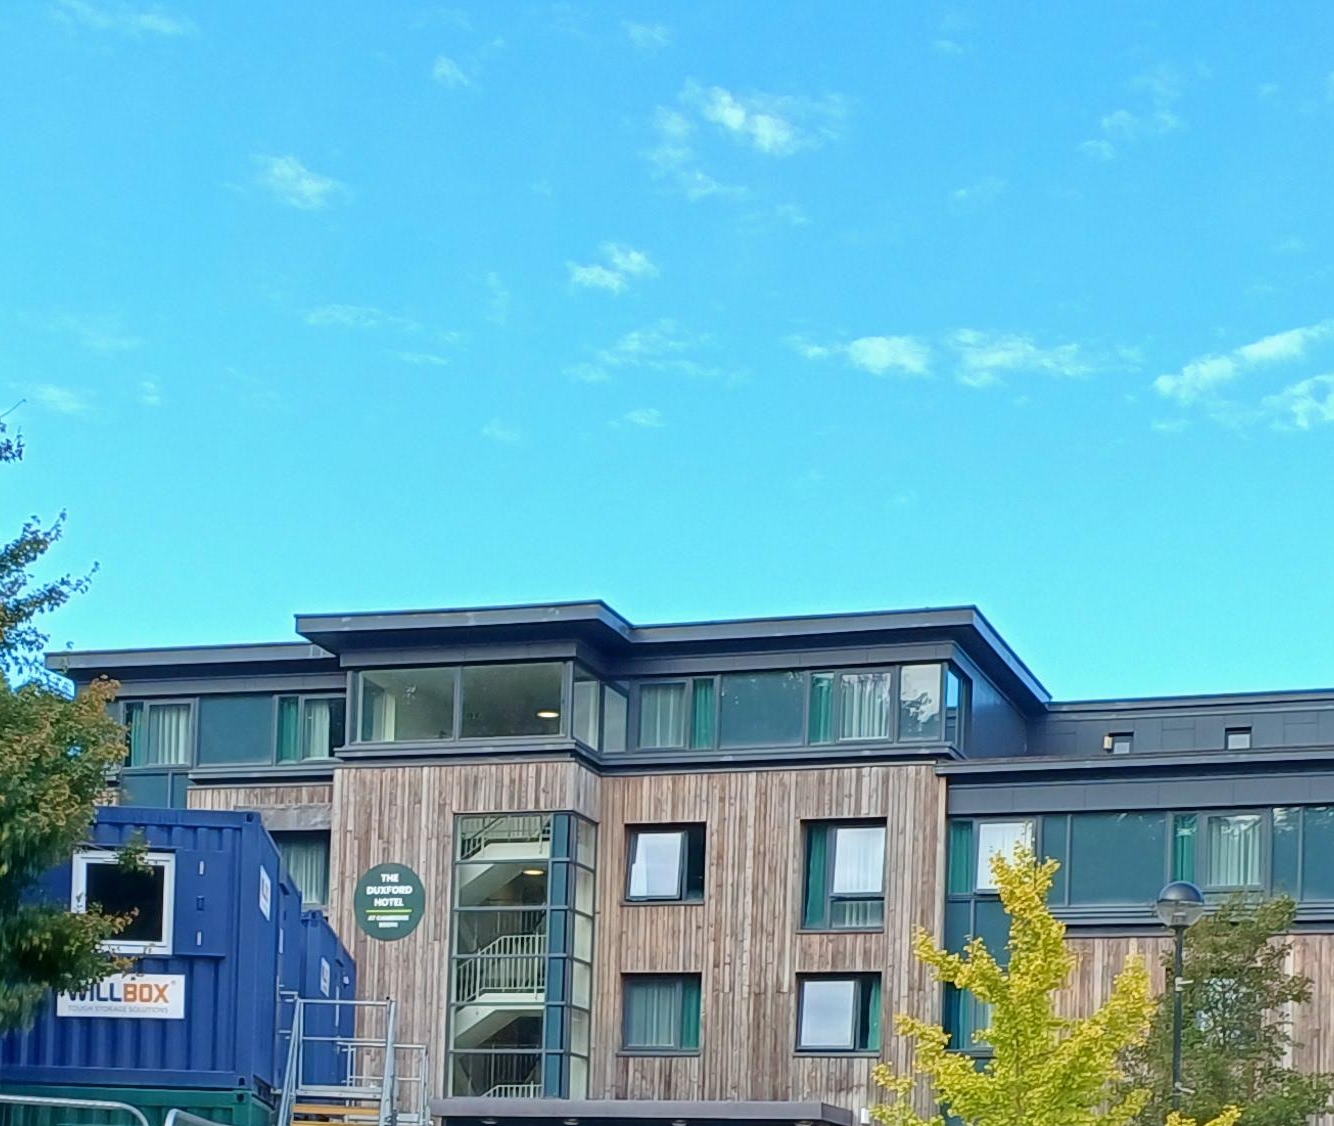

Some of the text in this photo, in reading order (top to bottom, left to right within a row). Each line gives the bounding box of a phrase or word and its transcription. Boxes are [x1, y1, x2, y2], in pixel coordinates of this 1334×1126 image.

[380, 873, 399, 883] THE
[366, 885, 413, 895] DUXFORD
[373, 897, 405, 907] HOTEL
[68, 983, 169, 1003] WILLBOX
